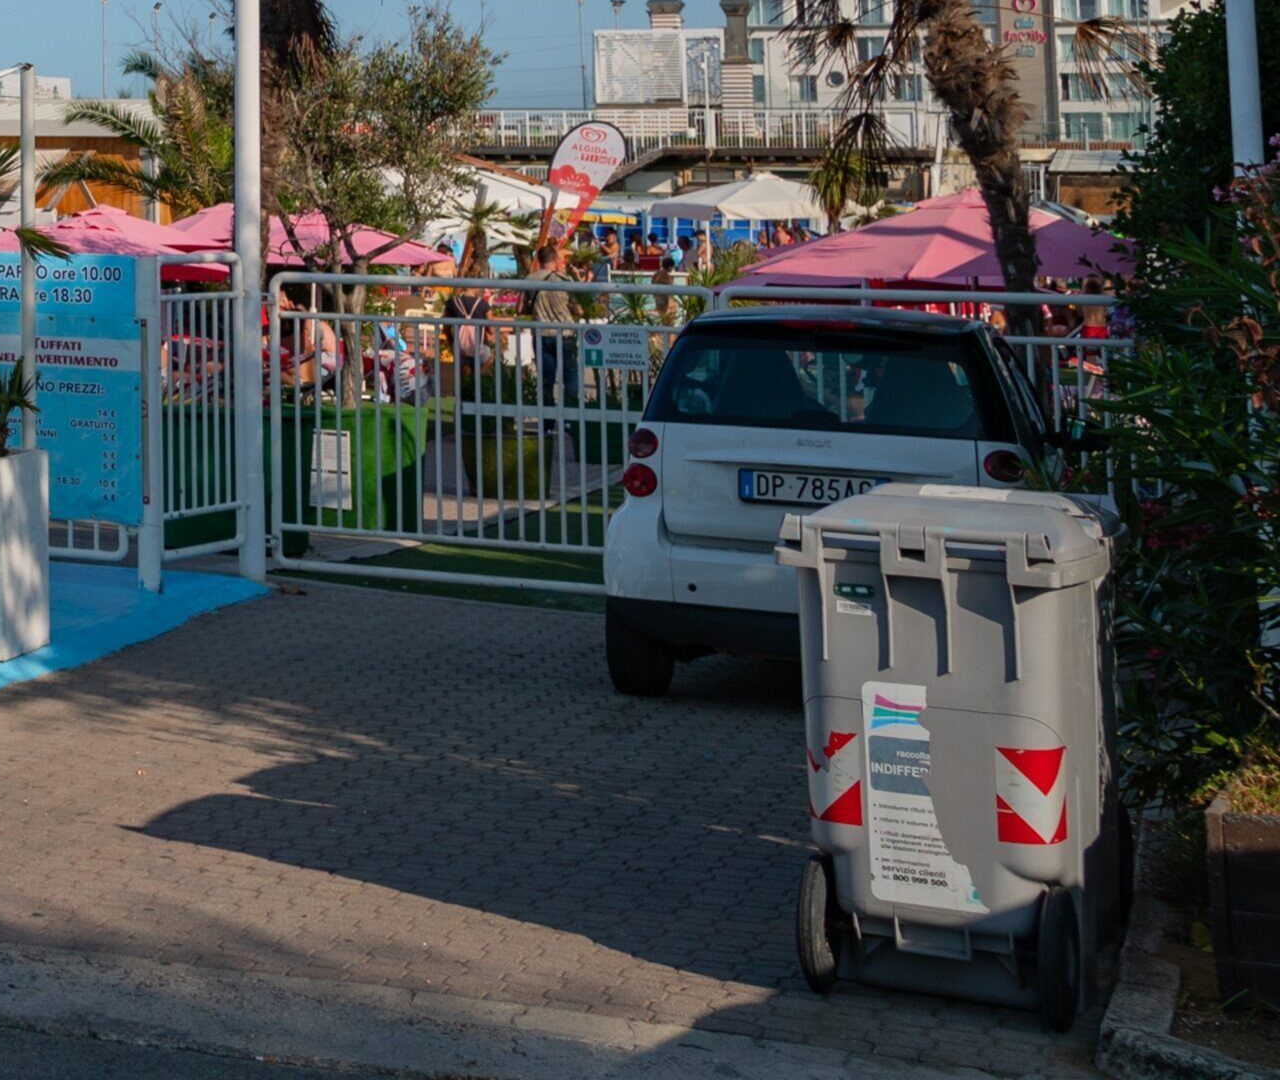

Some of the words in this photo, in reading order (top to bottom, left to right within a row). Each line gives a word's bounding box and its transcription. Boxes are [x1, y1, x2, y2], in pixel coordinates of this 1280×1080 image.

[571, 142, 608, 156] ALGIDA
[53, 270, 76, 281] ore
[81, 266, 122, 281] 10.00
[53, 289, 92, 304] 18.30
[35, 354, 119, 367] IVERTIMENTO
[59, 383, 104, 395] PREZZI:
[70, 420, 116, 430] GRATUITO
[756, 474, 785, 498] DP
[882, 864, 917, 875] servizio
[918, 868, 947, 879] clienti
[930, 878, 948, 887] 500
